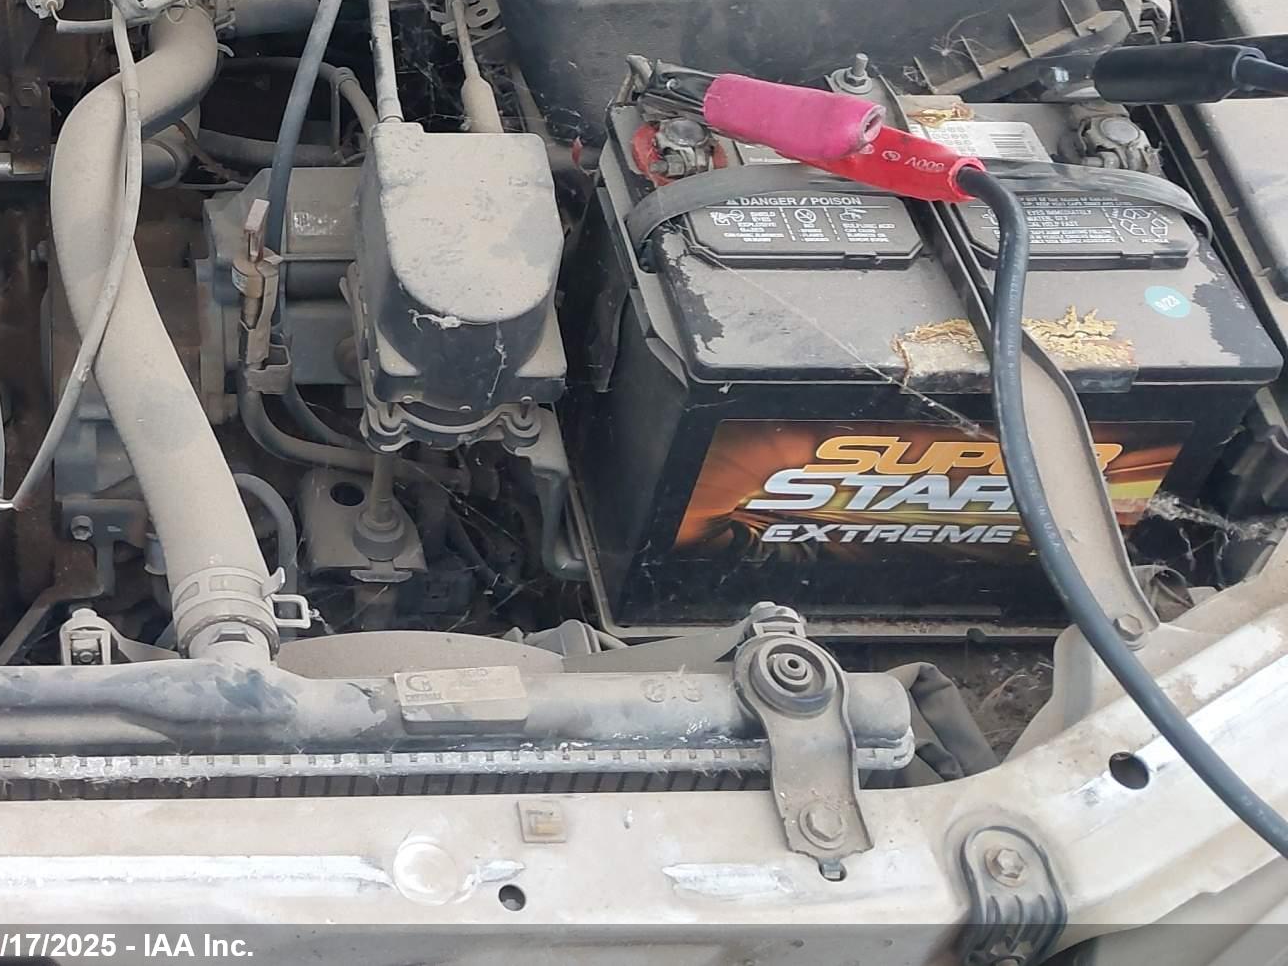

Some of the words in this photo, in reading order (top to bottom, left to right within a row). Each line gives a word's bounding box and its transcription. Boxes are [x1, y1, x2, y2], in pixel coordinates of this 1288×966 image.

[741, 197, 796, 206] DANGER
[811, 197, 862, 205] POISON
[802, 436, 1123, 476] SUP
[746, 469, 1015, 510] STAR
[761, 524, 1021, 543] EXTREME
